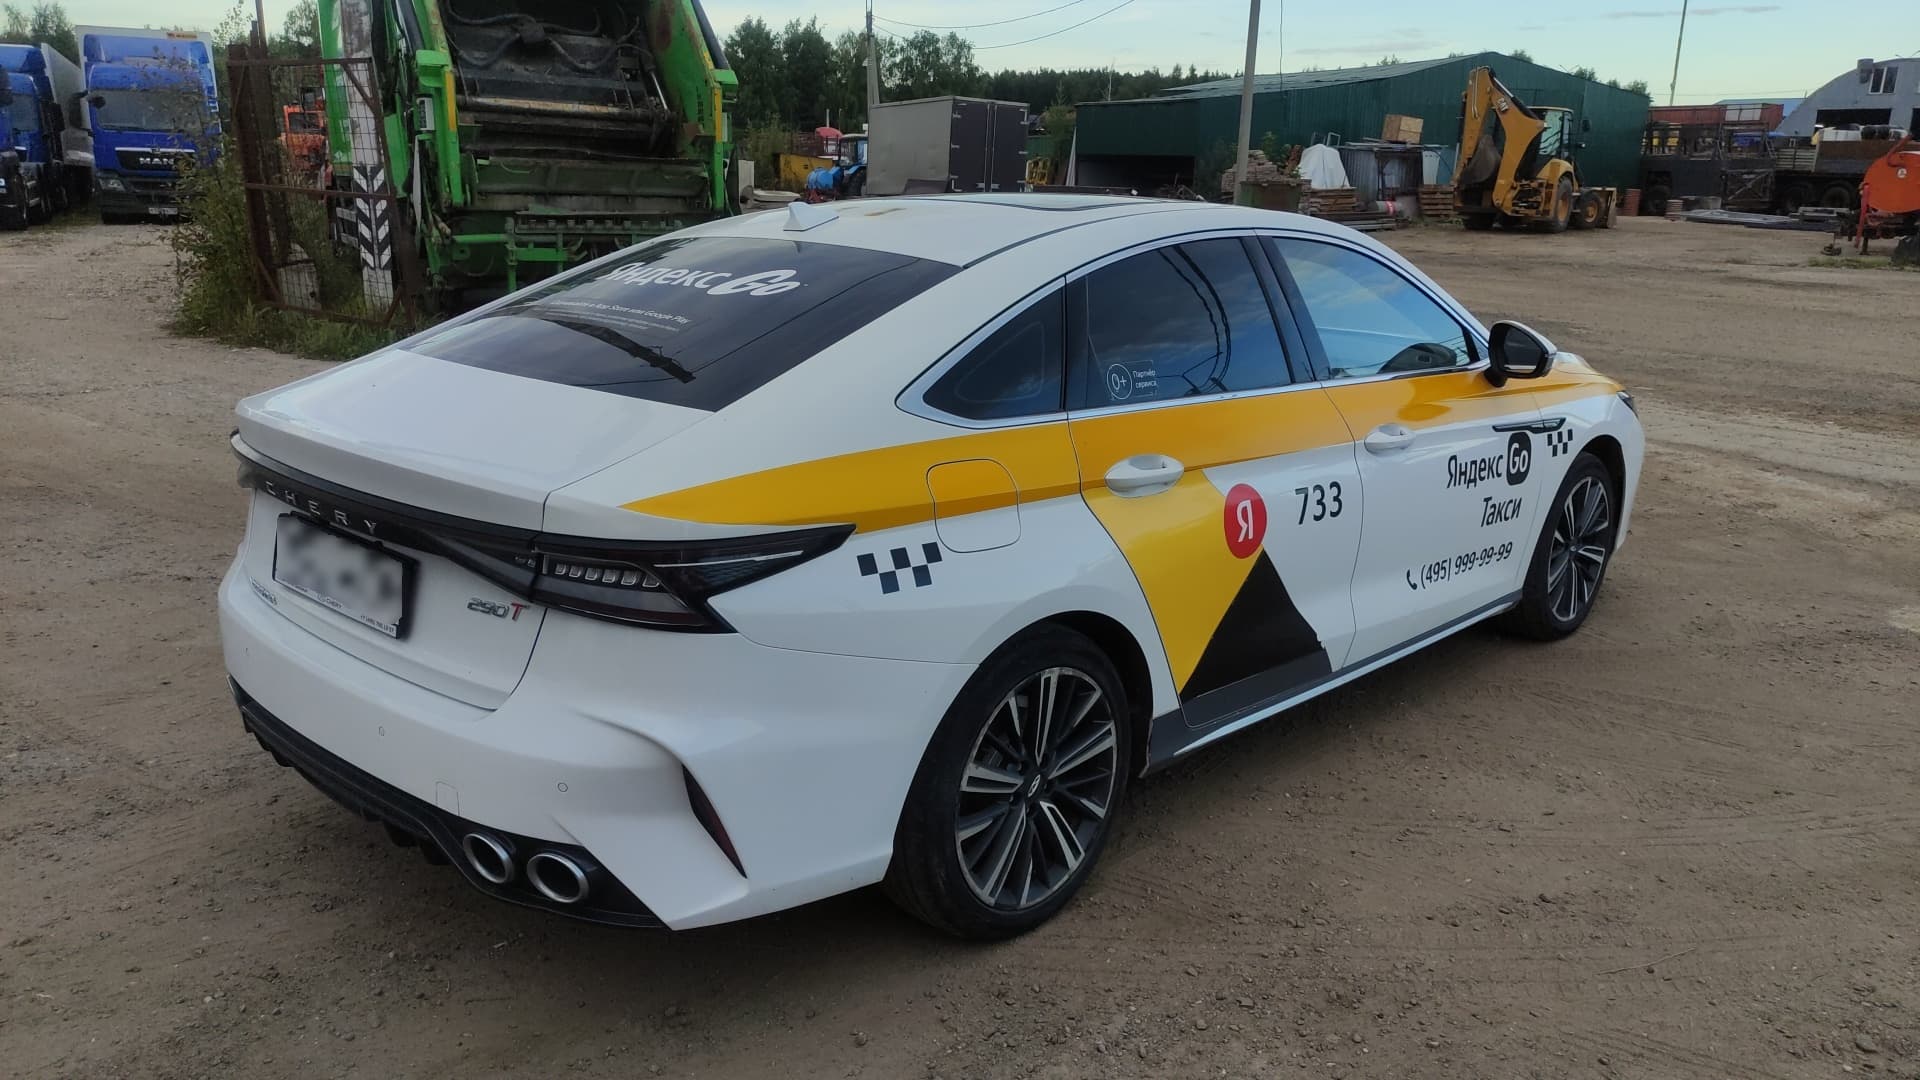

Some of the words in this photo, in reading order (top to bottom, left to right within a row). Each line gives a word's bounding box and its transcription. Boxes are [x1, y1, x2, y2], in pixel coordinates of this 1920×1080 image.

[139, 157, 175, 166] MAN
[600, 262, 732, 288] Яндекс
[707, 269, 800, 296] Go
[644, 310, 673, 321] Google
[1112, 373, 1127, 391] 0+
[1446, 454, 1503, 489] Яндекс
[1509, 442, 1529, 475] Go
[266, 481, 377, 534] CHERY
[1295, 481, 1343, 525] 733
[1481, 496, 1522, 528] Такси
[1236, 499, 1254, 543] Я
[1420, 557, 1452, 589] (495)
[1454, 541, 1513, 575] 999-99-99
[466, 597, 530, 621] 290T
